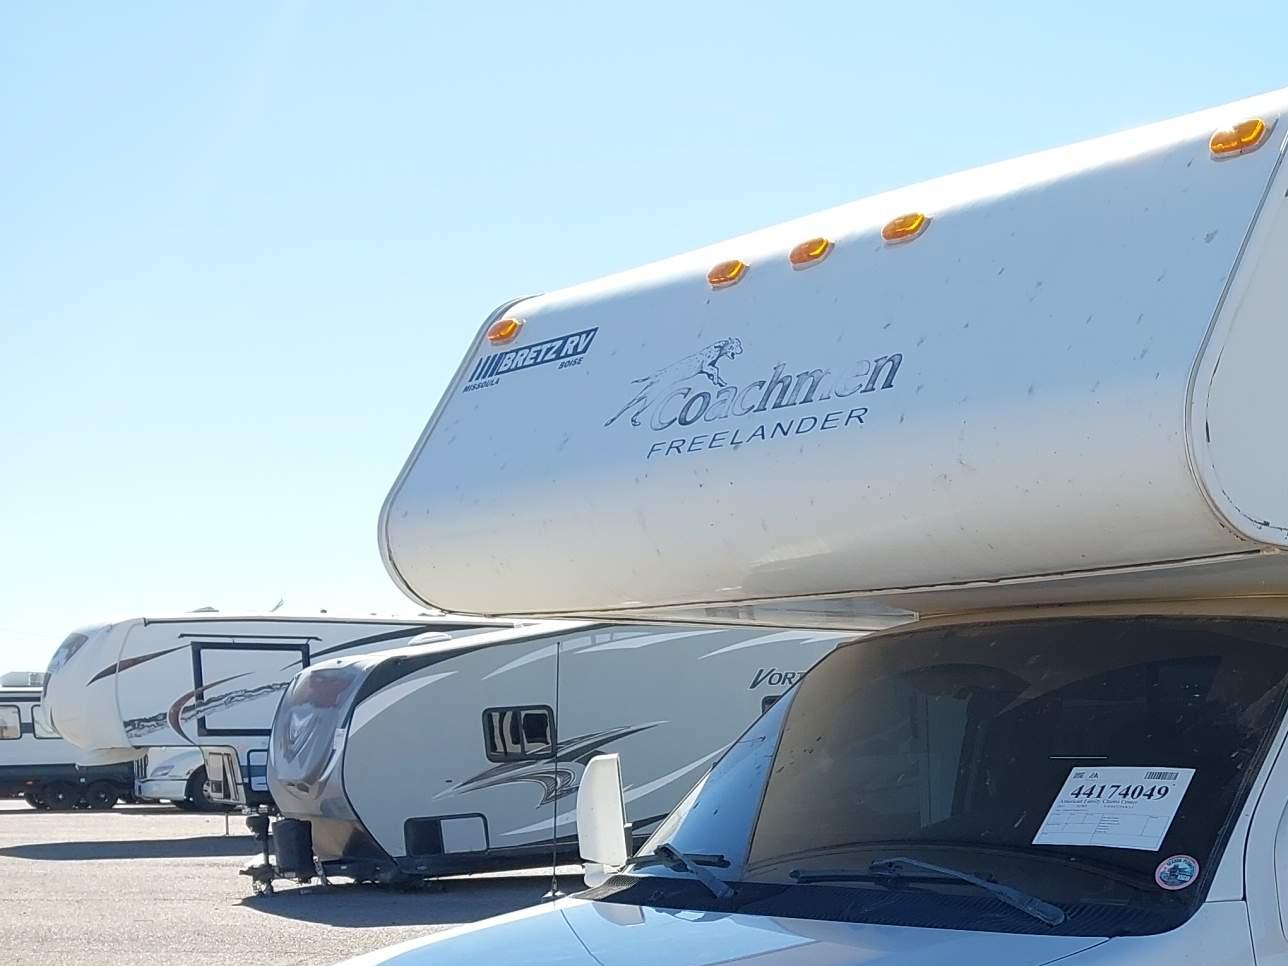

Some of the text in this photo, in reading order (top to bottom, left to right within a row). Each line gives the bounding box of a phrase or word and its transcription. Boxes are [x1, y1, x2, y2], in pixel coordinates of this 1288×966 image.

[497, 331, 596, 374] BRETZ RV
[558, 356, 584, 370] BOISE
[463, 377, 501, 392] MISSOULA
[650, 353, 903, 431] Coachmen
[647, 407, 868, 459] FREELANDER
[1071, 784, 1169, 800] 44174049
